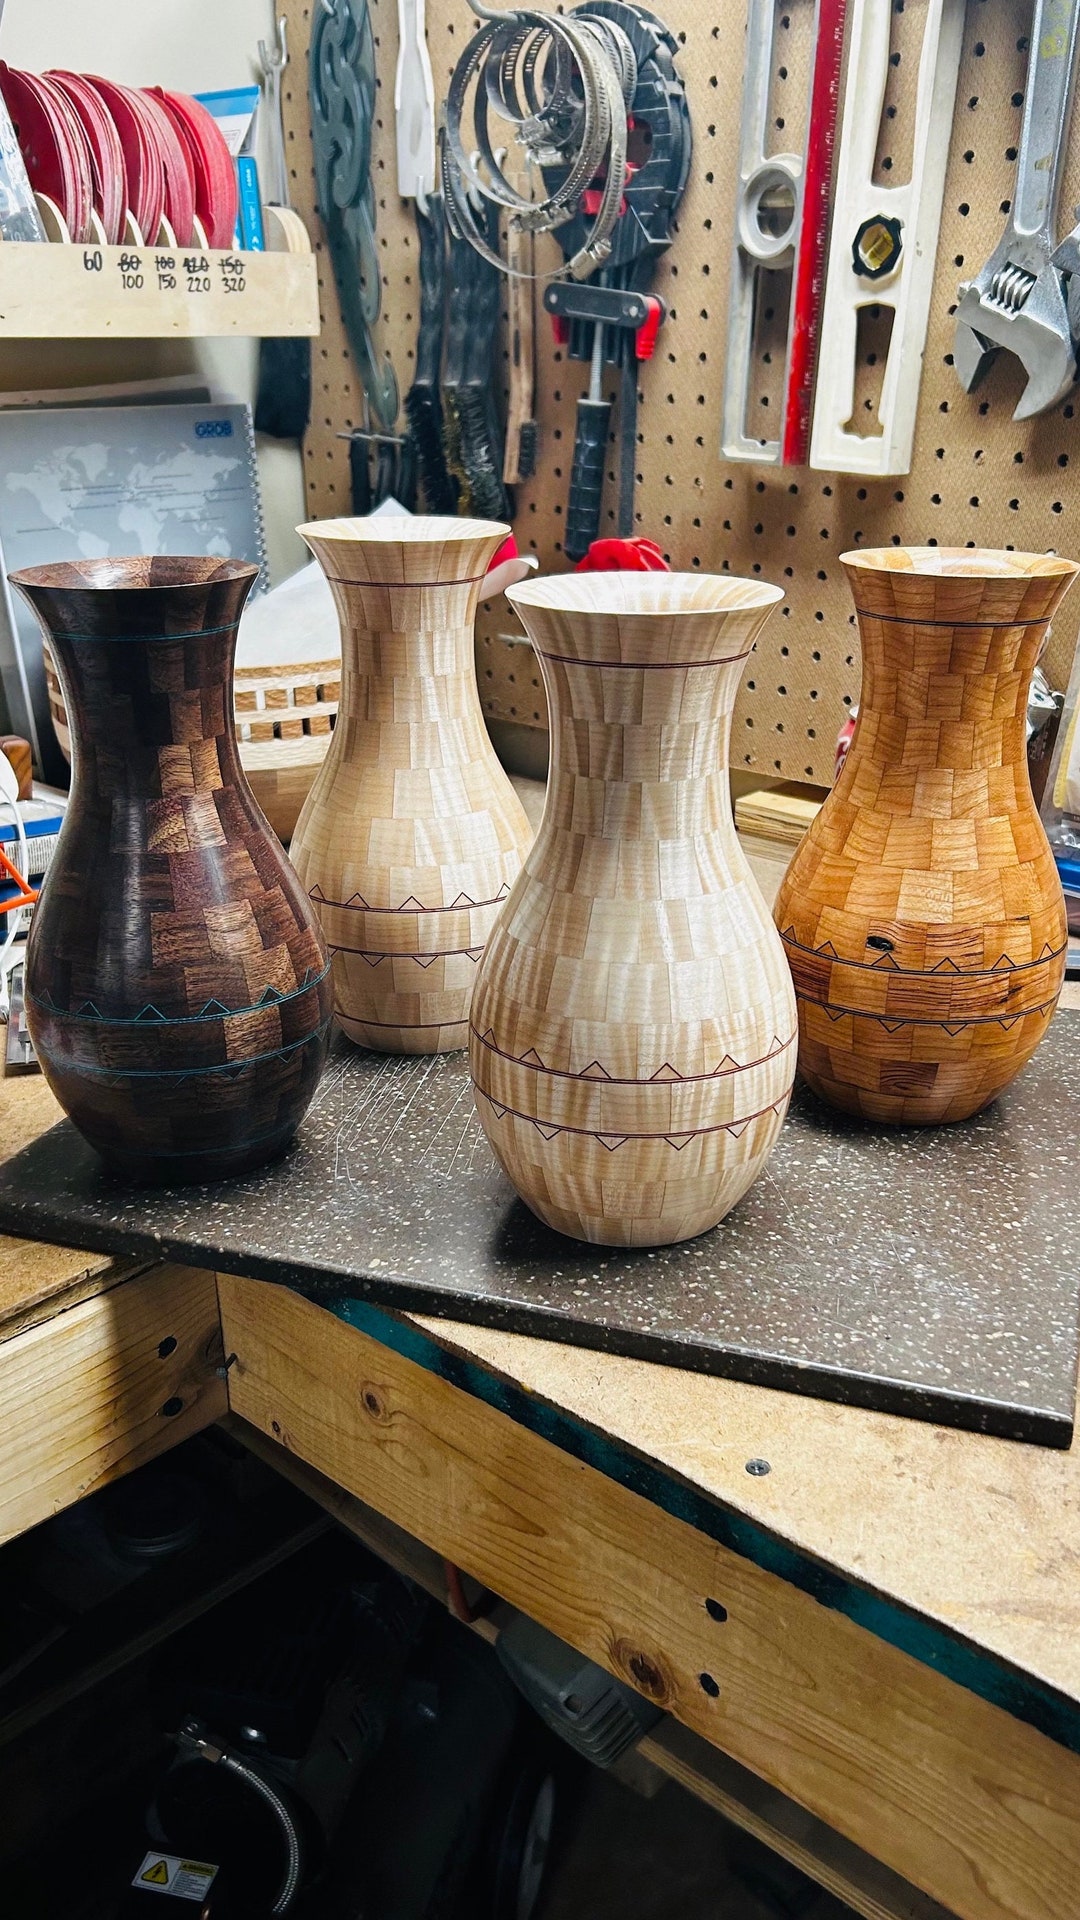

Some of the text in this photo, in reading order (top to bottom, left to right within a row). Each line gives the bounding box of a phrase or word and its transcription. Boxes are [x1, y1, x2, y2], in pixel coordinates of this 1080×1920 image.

[83, 251, 103, 271] 60
[122, 274, 246, 293] 100 150 220 320
